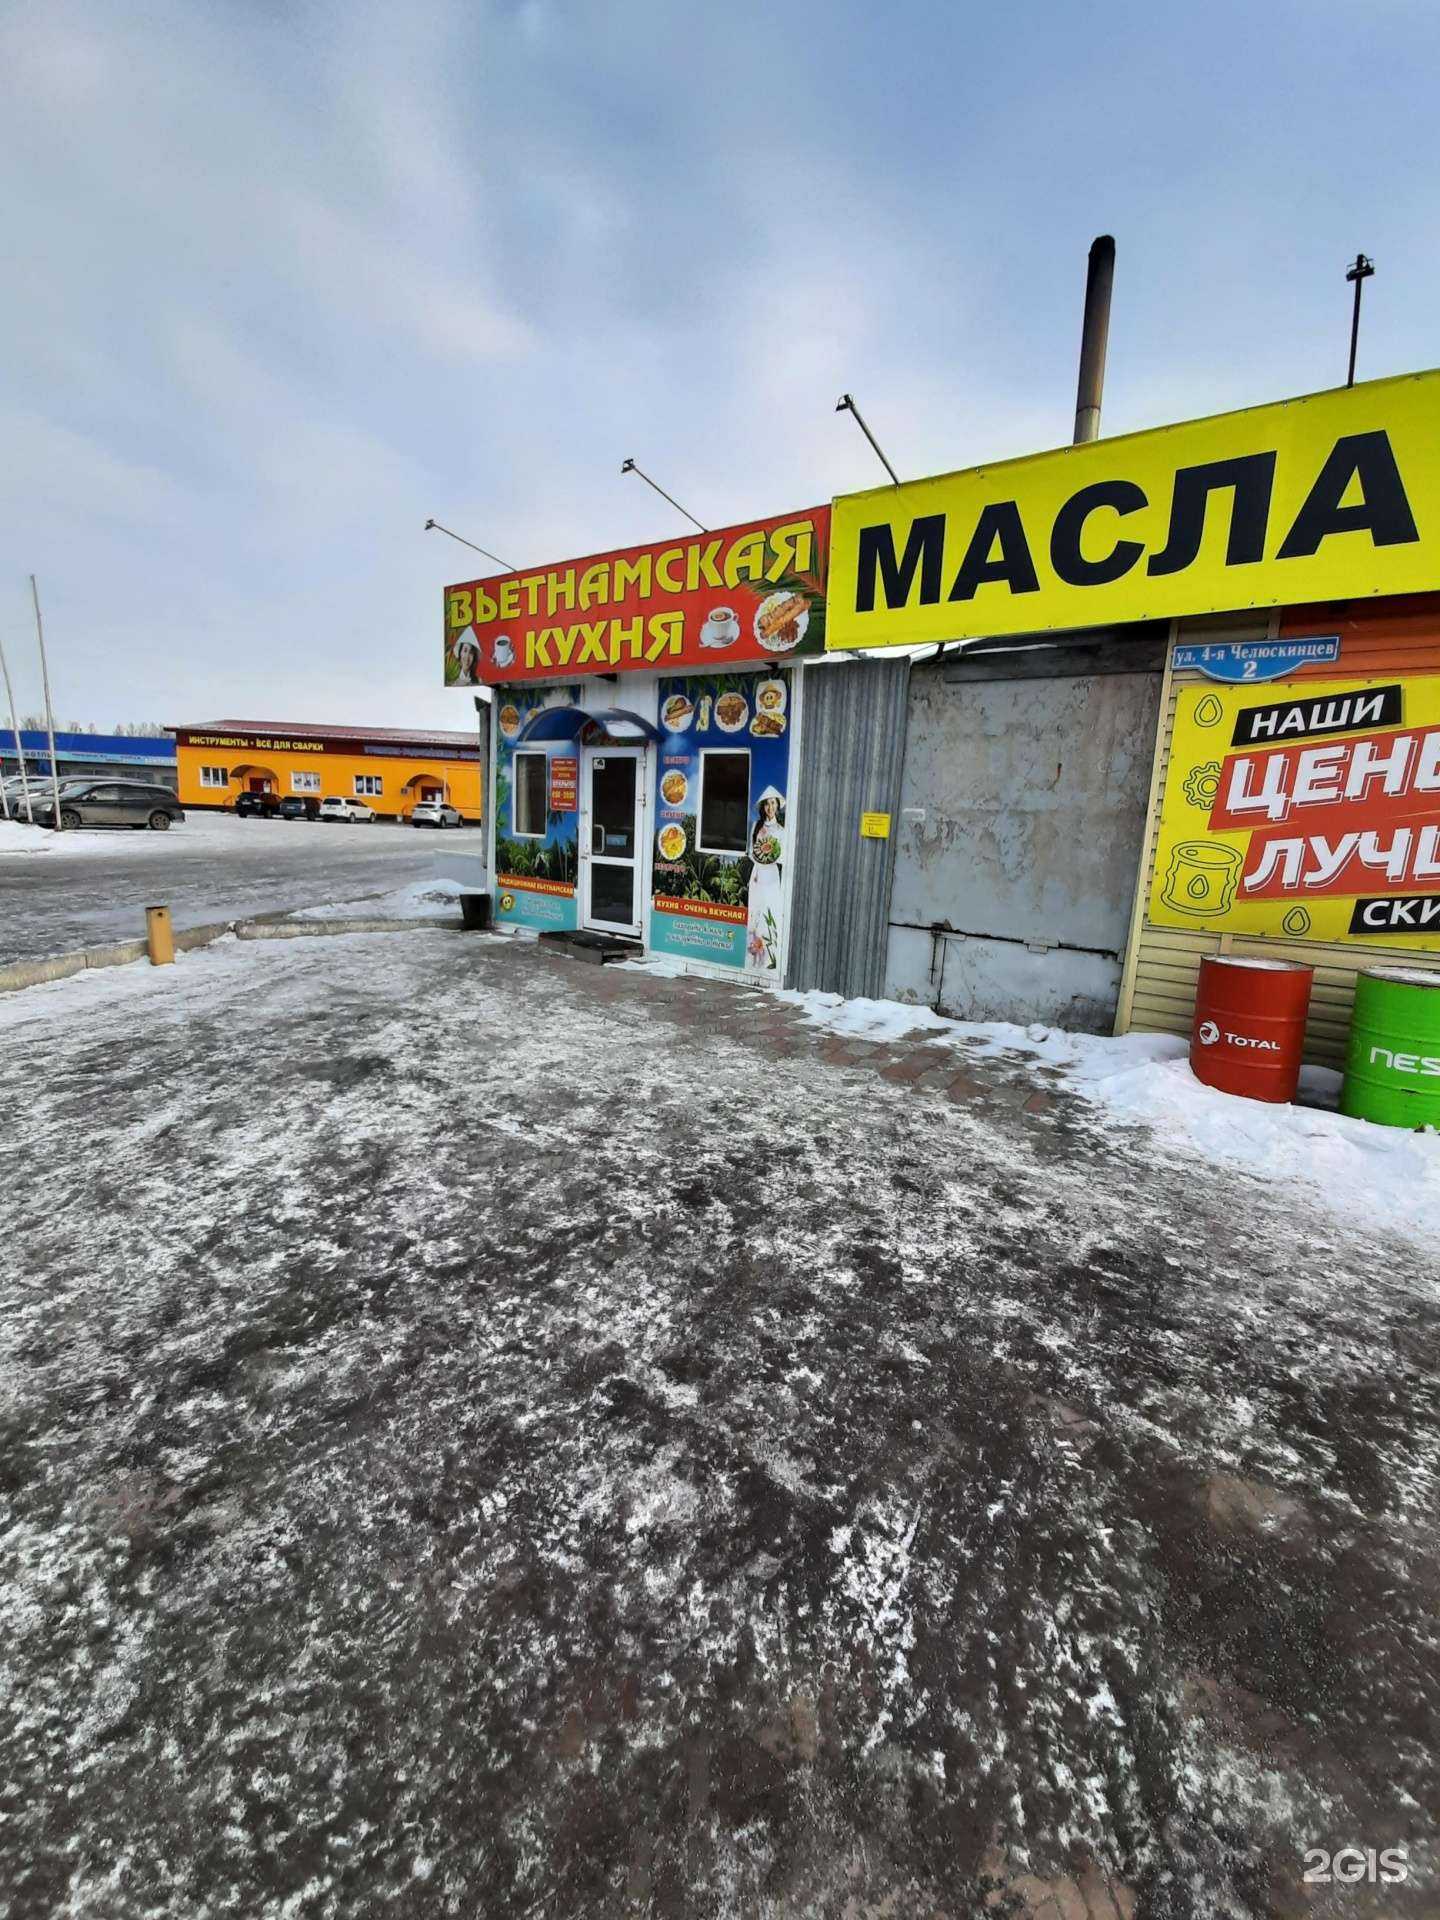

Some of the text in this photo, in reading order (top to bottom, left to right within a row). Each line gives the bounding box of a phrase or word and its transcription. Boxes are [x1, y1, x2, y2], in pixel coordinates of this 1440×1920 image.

[855, 429, 1420, 613] МАСЛА
[449, 520, 814, 628] ВЬЕТНАМСКАЯ
[524, 610, 685, 669] КУХНЯ
[1175, 643, 1335, 667] ул. 4-я Челюскинцев
[1242, 661, 1258, 679] 2
[1250, 693, 1386, 739] НАШИ
[188, 735, 249, 748] ИНСТРУМЕНТЫ
[273, 740, 291, 751] ДЛЯ
[292, 742, 324, 752] СВАРКИ
[656, 900, 746, 922] КУХНЯ ОЧЕНЬ ВКУСНАЯ!
[1224, 1032, 1281, 1050] TOTAL
